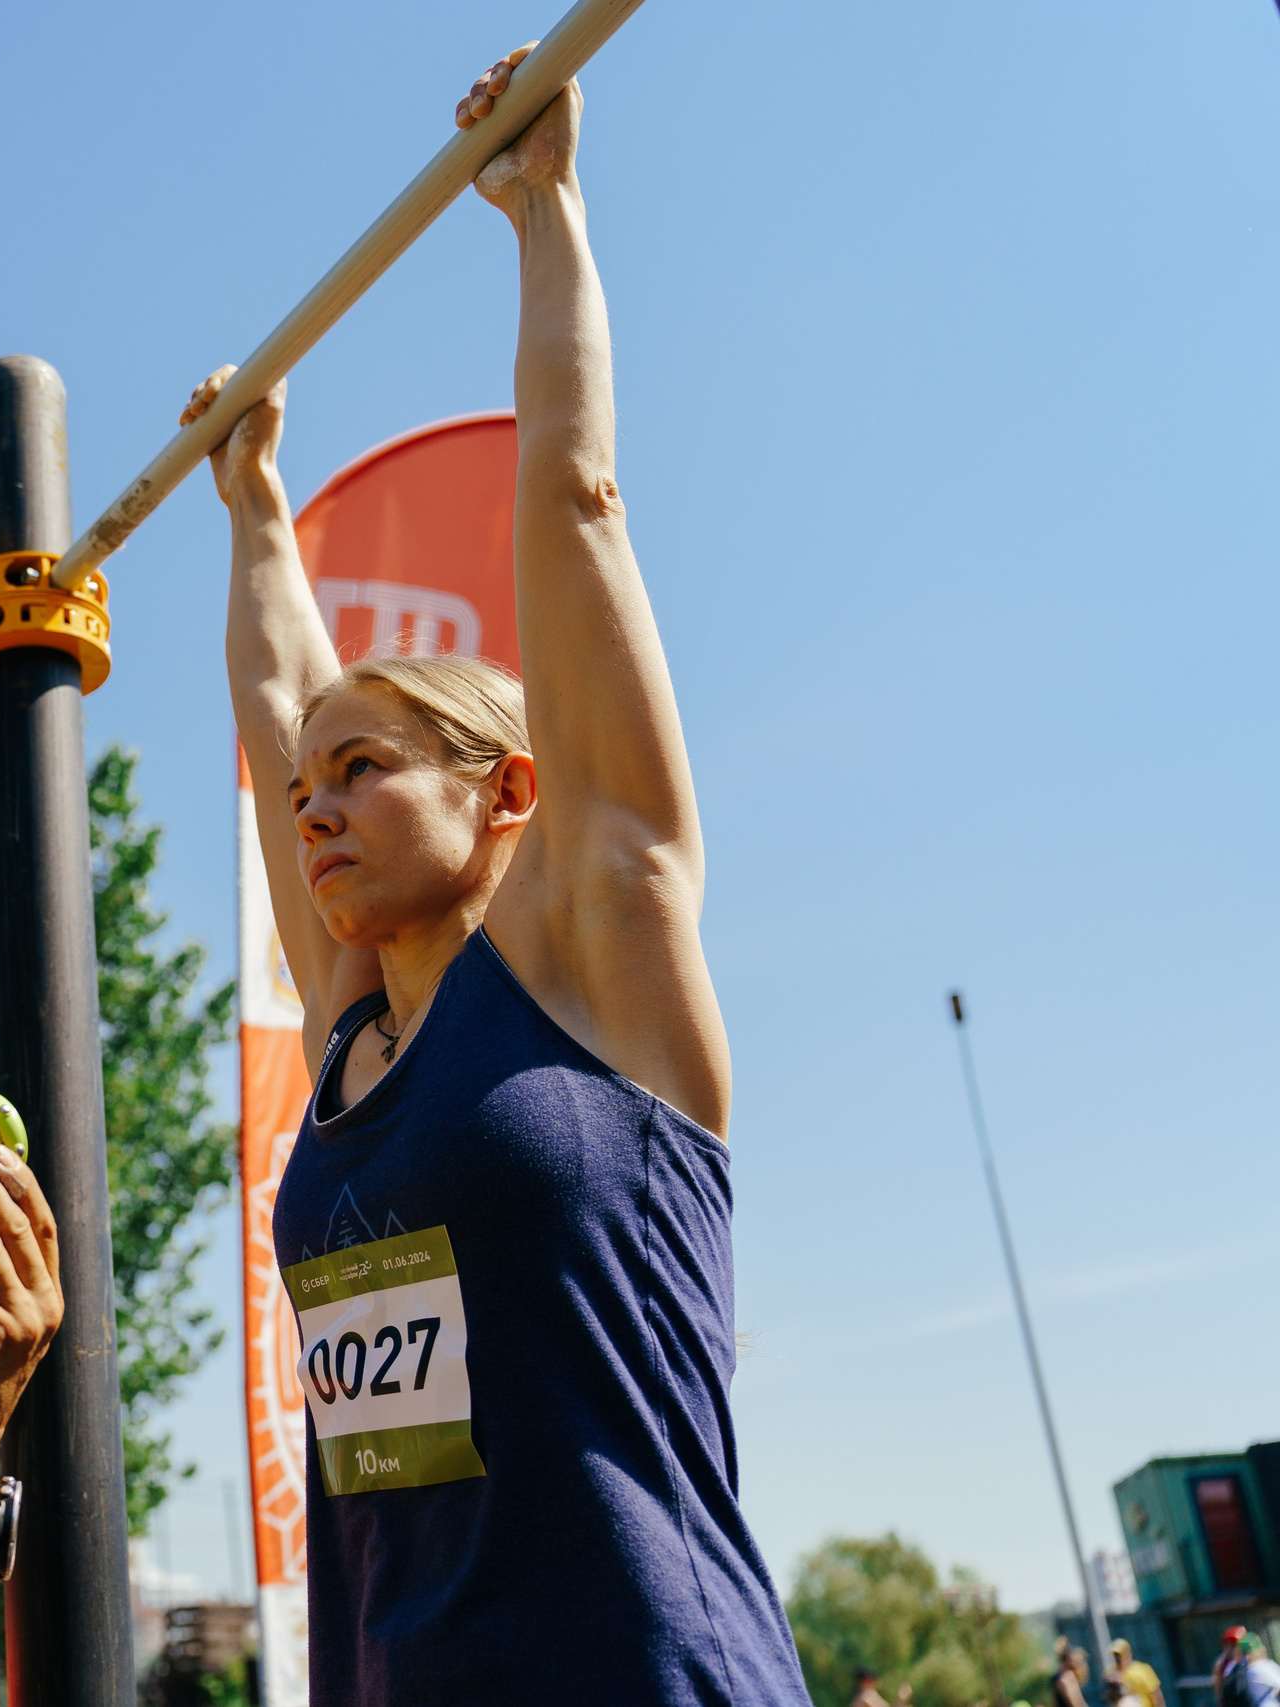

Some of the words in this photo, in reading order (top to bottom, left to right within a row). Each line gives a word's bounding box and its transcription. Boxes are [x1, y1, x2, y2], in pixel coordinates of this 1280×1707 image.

[383, 1250, 431, 1271] 01.06.2024
[310, 1275, 330, 1288] СБЕР
[308, 1317, 441, 1405] 0027
